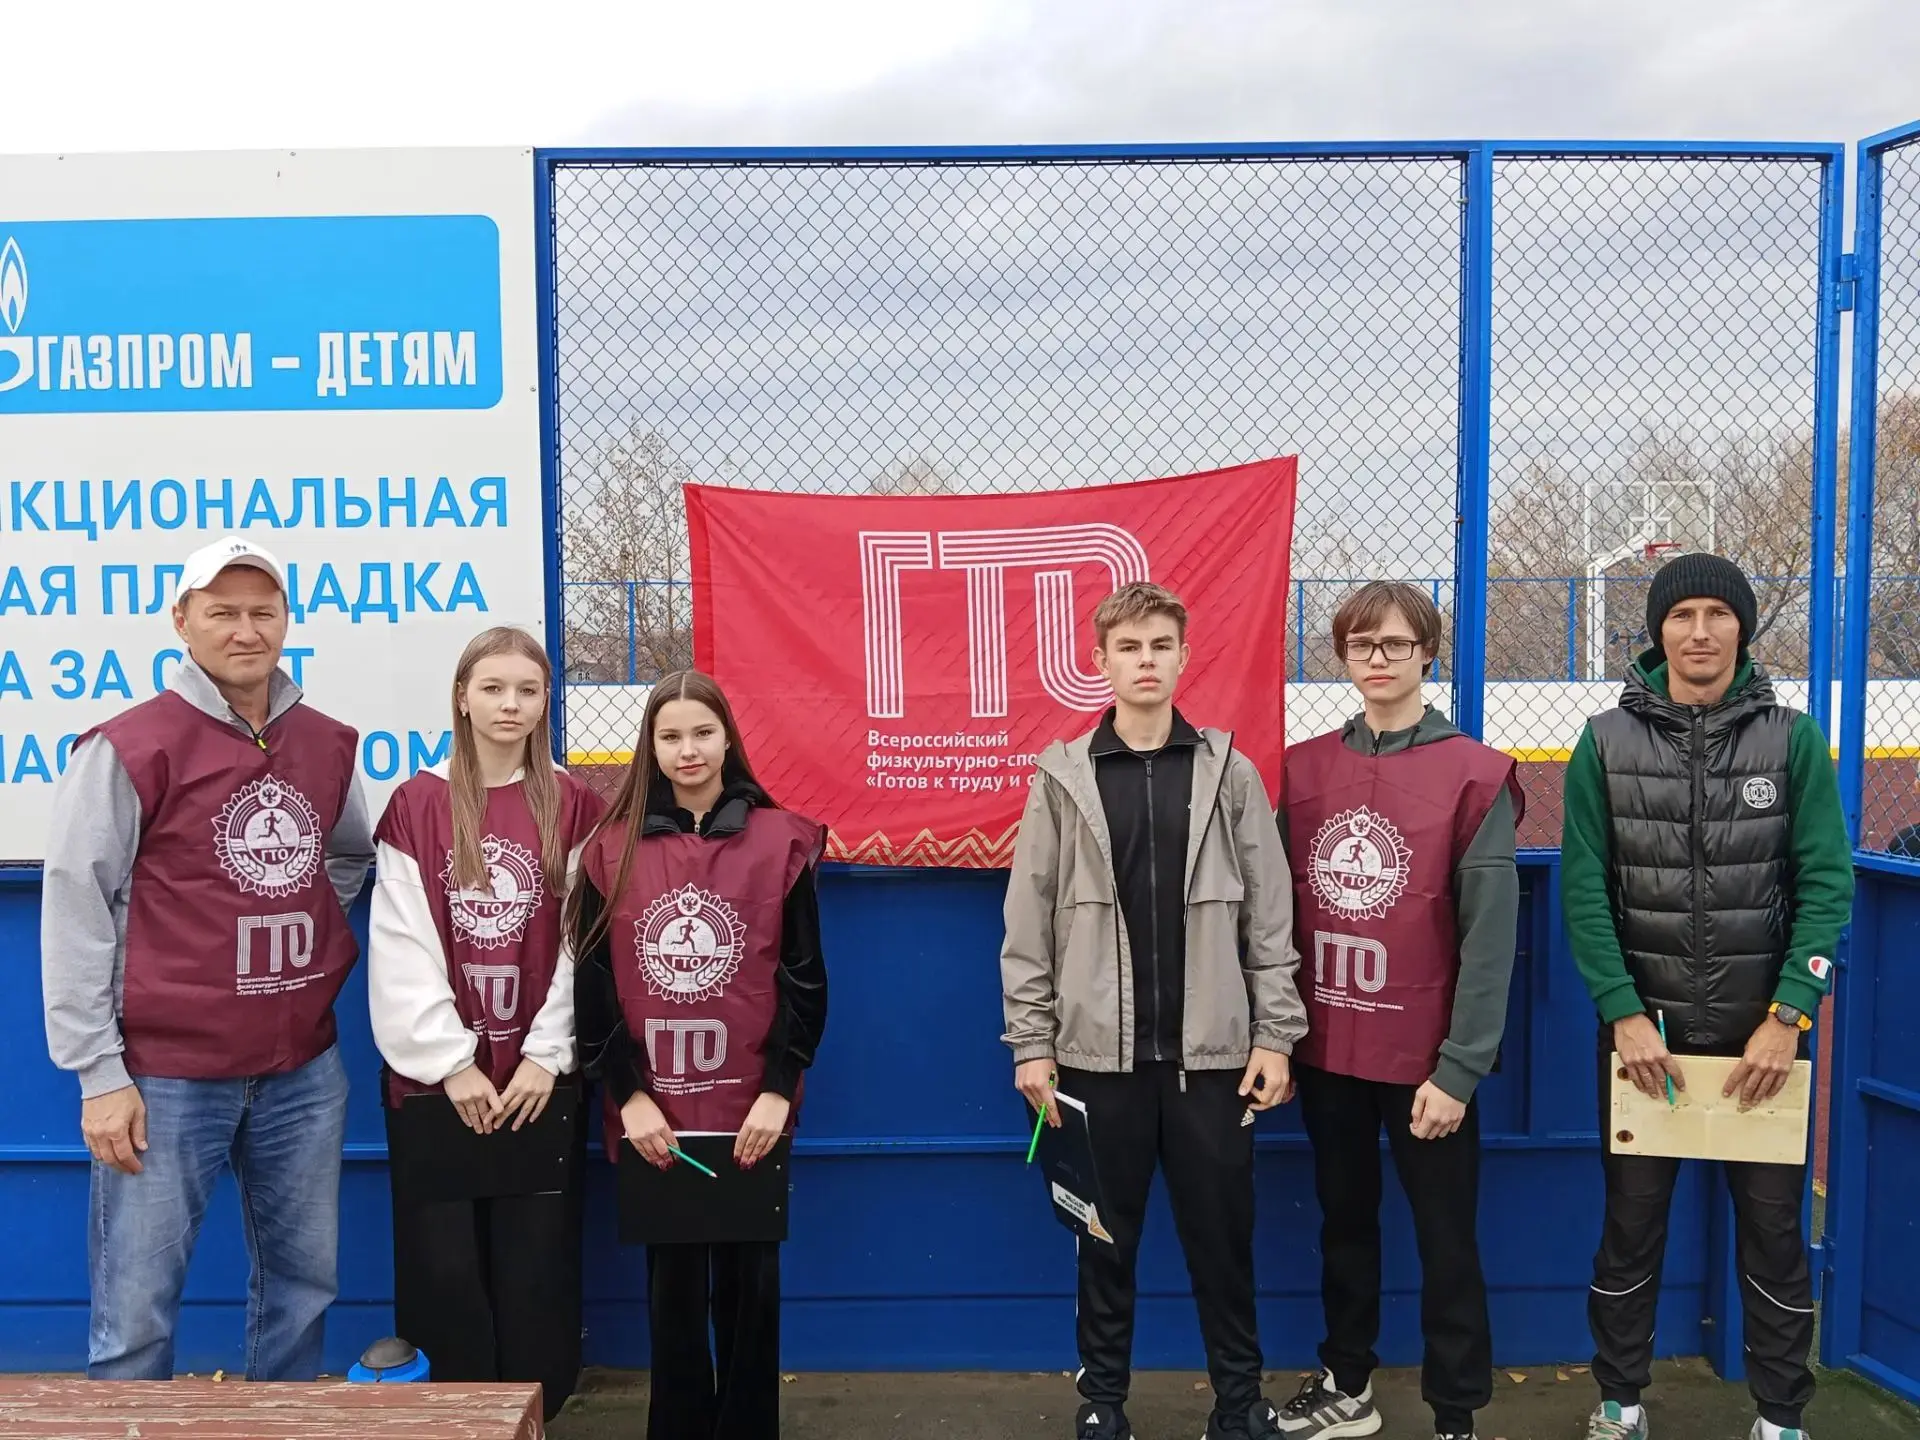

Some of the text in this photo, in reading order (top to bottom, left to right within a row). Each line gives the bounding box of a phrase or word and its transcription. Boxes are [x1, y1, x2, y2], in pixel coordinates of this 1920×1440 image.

[38, 333, 253, 391] ГАЗПРОМ
[317, 331, 477, 397] ДЕТЯМ
[0, 477, 508, 541] КЦИОНАЛЬНАЯ
[0, 565, 77, 616] АЯ
[859, 522, 1151, 718] ГТО
[50, 649, 134, 700] ЗА
[867, 730, 1009, 751] Всероссийский
[866, 772, 928, 789] «Готов
[934, 776, 944, 788] к
[949, 775, 1004, 793] труду
[1009, 775, 1020, 787] и
[261, 848, 289, 863] ГТО
[1340, 873, 1368, 887] ГТО
[474, 901, 503, 915] ГТО
[237, 911, 314, 975] ГТО
[671, 956, 701, 970] ГТО
[1314, 930, 1388, 993] ГТО
[644, 1019, 728, 1075] ГТО
